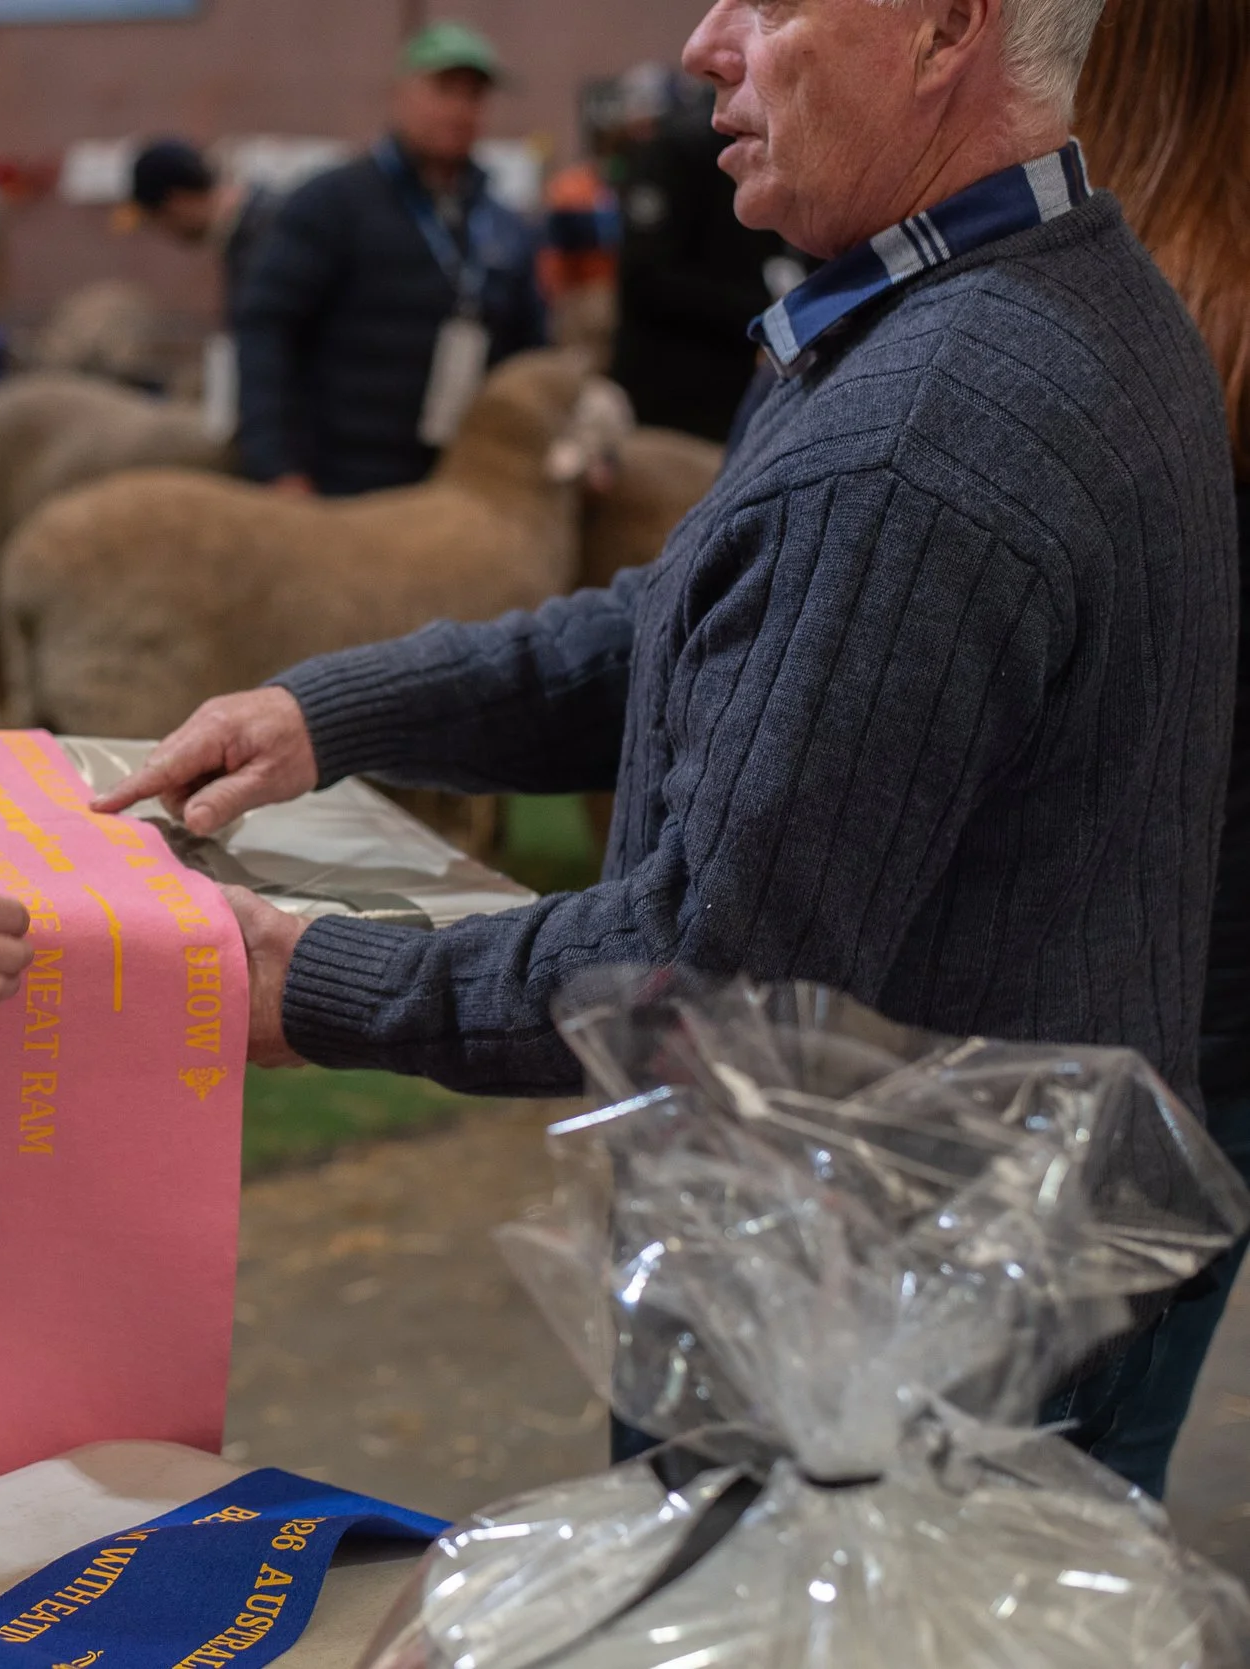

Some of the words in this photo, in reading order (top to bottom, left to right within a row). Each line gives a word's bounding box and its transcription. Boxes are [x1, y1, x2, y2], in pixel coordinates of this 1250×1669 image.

[23, 948, 63, 1059] MEAT
[144, 872, 210, 934] WOOL
[185, 946, 222, 1054] SHOW
[19, 1071, 59, 1156] RAM
[54, 1547, 138, 1605] WITH
[171, 1563, 293, 1669] AUSTRAL
